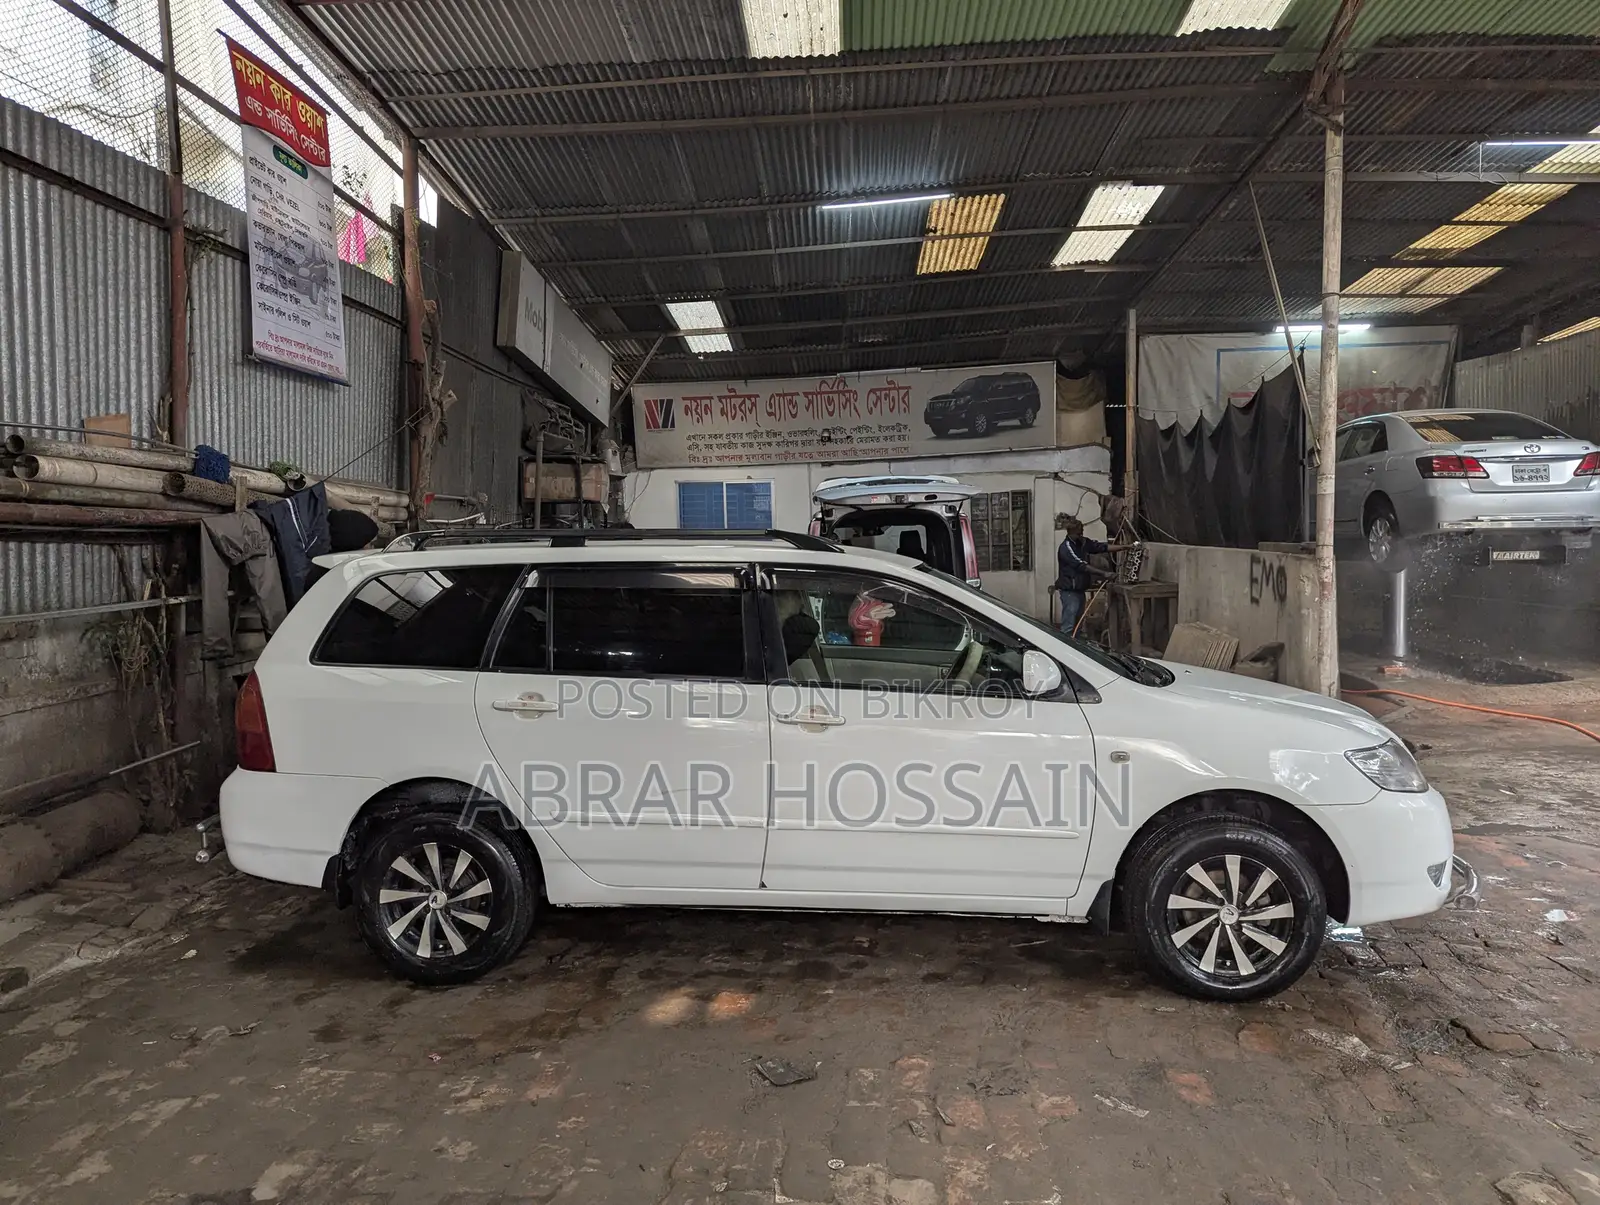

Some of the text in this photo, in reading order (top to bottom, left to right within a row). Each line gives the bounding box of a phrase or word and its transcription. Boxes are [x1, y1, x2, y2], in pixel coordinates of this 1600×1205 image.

[232, 50, 326, 138] নয়ন কার ওয়াশ
[263, 105, 300, 144] সার্ভিসিং
[300, 134, 326, 163] সেন্টার
[682, 395, 715, 426] নয়ন
[717, 384, 762, 428] মটরস্
[765, 387, 800, 421] এ্যান্ড
[802, 376, 861, 421] সার্ভিসিং
[866, 376, 912, 417] সেন্টার
[686, 433, 706, 442] এখানে
[725, 432, 743, 440] প্রকার
[704, 444, 715, 452] সহ
[715, 440, 738, 450] যাবতীয়
[740, 441, 754, 449] কাজ
[775, 438, 798, 448] কারিগর
[856, 436, 881, 444] মেরামত
[883, 434, 896, 443] করা
[715, 454, 743, 463] আপনার
[816, 450, 839, 459] আমরা
[840, 447, 859, 457] আছি
[859, 447, 889, 457] আপনার
[891, 446, 910, 455] পাশে
